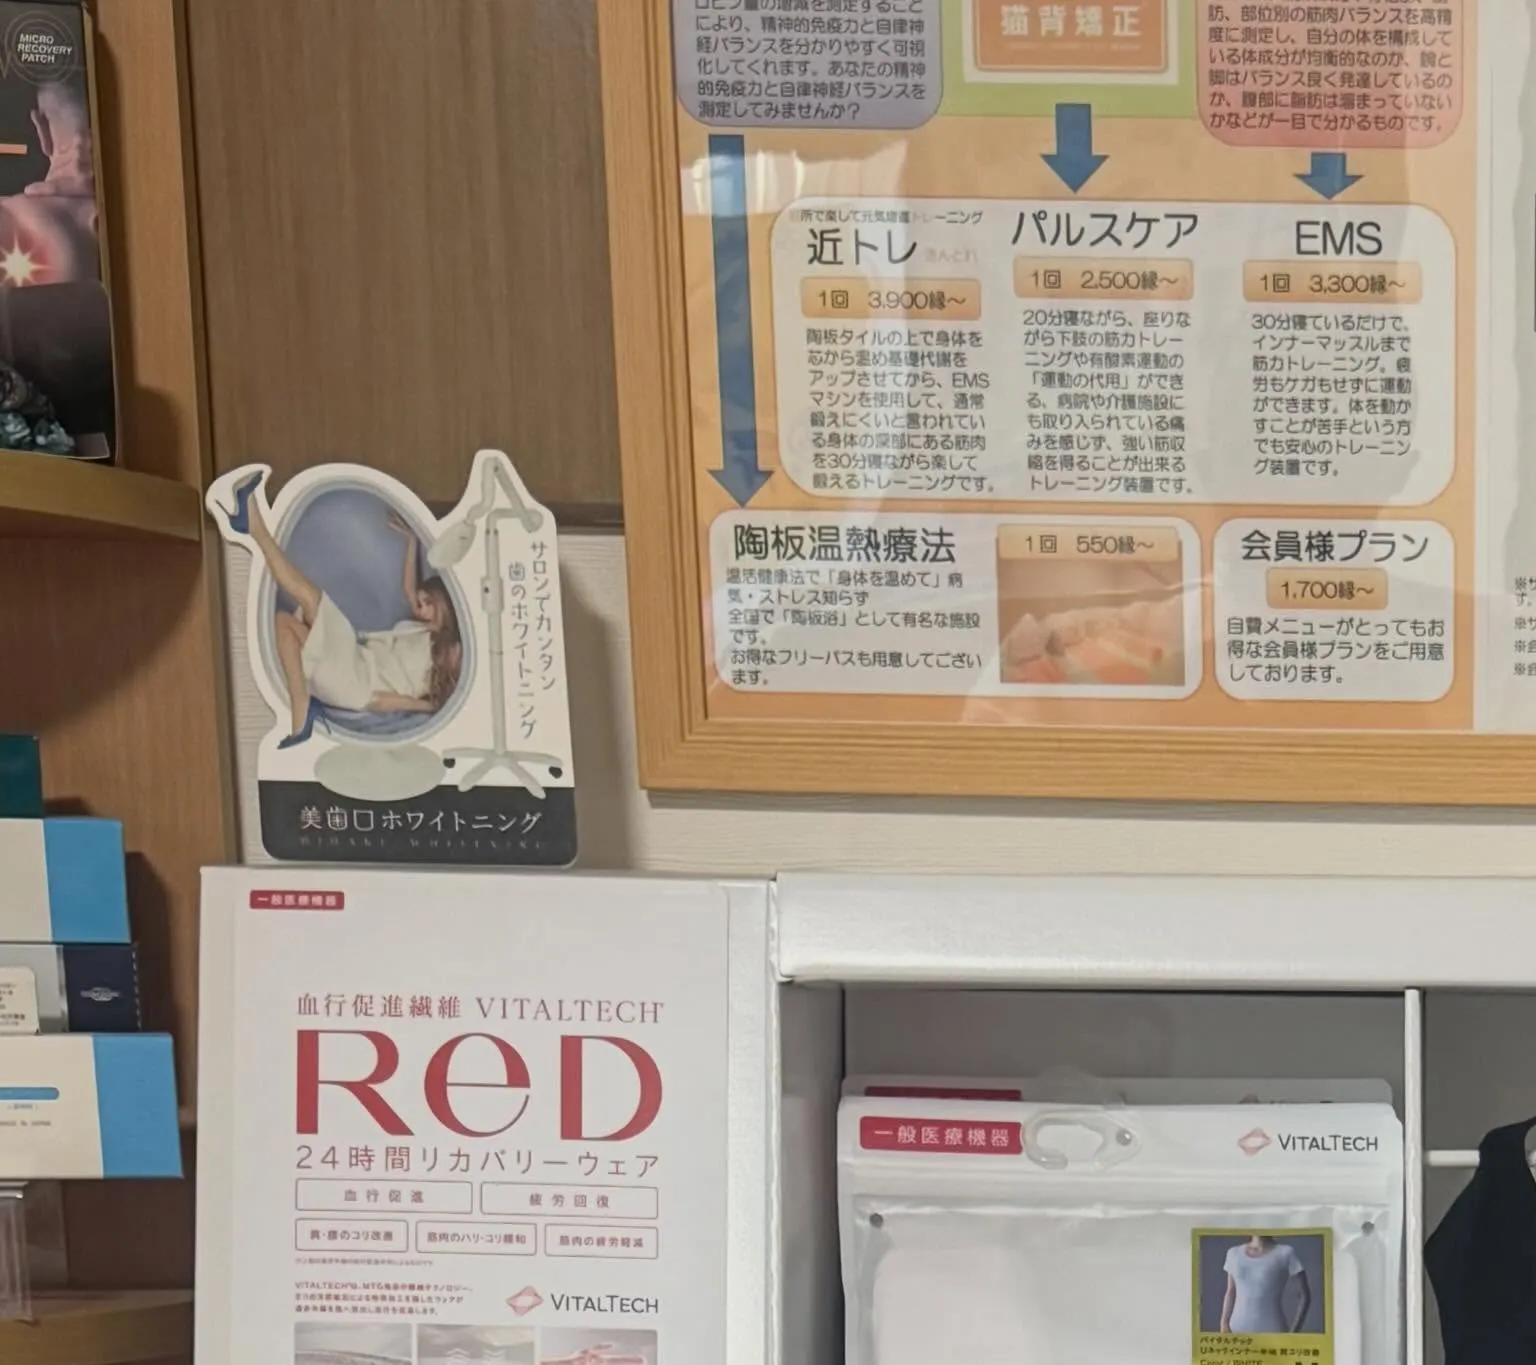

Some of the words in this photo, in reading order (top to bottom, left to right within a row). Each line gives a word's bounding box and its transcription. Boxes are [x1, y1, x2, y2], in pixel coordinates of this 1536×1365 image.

[1001, 4, 1142, 37] 猫背矯正
[17, 43, 73, 56] RECOVERY
[20, 33, 55, 45] MICRO
[21, 53, 56, 64] PATCH
[1011, 210, 1200, 250] パルスケア
[1295, 221, 1384, 256] EMS
[807, 227, 917, 266] 近トレ
[734, 524, 956, 565] 陶板温熱療法
[1242, 530, 1430, 565] 会員様プラン
[1228, 640, 1446, 663] 得な会員様プランをご用意
[1229, 664, 1349, 684] しております。
[297, 992, 462, 1019] 血行促進繊維
[873, 1123, 1010, 1148] 一般医療機器
[296, 1145, 660, 1179] 24時間リカバリーウェア
[343, 1189, 425, 1205] 血行促進
[528, 1194, 611, 1210] 疲労回復
